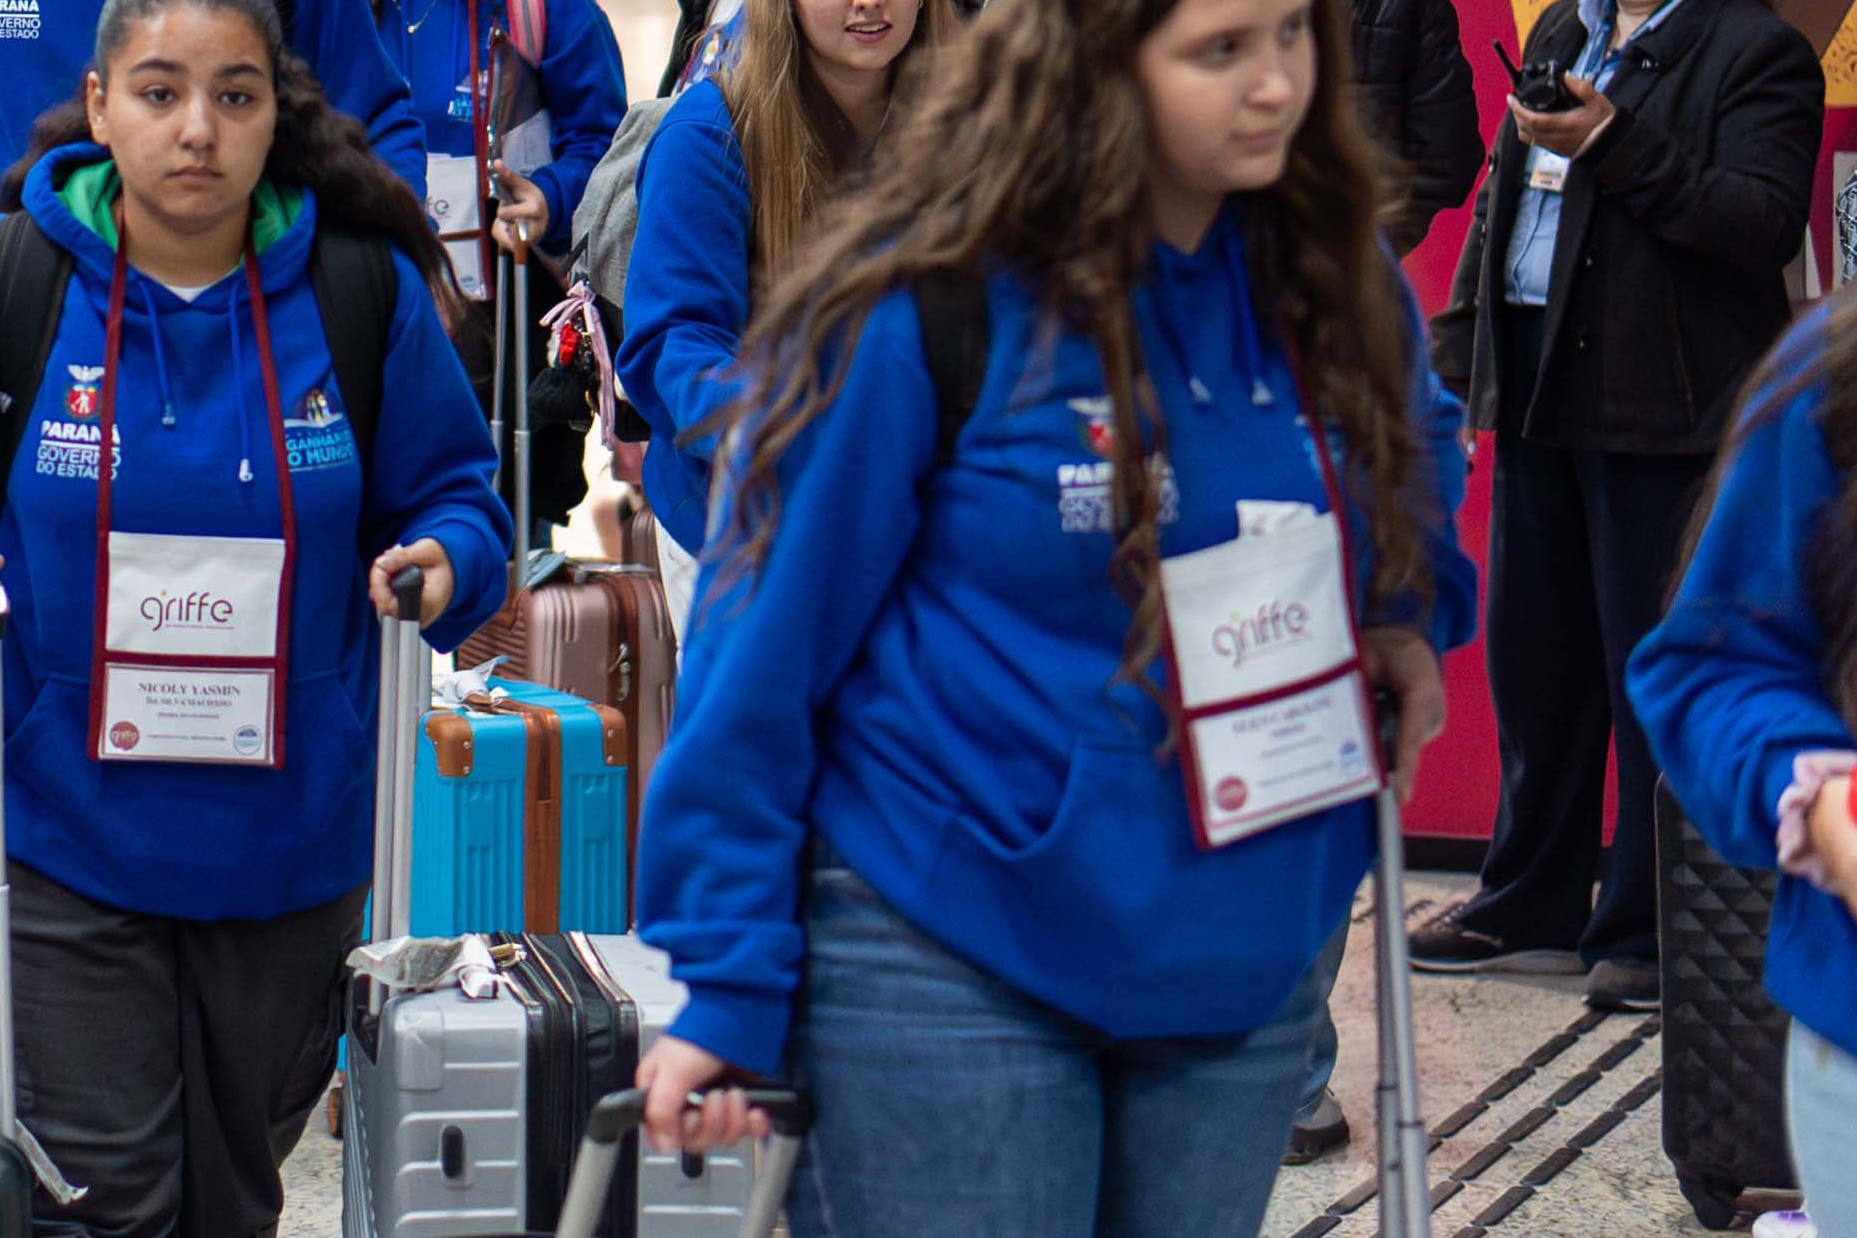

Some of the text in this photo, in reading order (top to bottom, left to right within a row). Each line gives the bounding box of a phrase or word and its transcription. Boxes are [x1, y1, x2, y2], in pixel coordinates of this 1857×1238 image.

[36, 460, 55, 474] DO
[287, 451, 302, 467] O
[140, 591, 233, 632] griffe
[1212, 596, 1309, 668] griffe
[138, 682, 241, 696] NICOLY YASMIN
